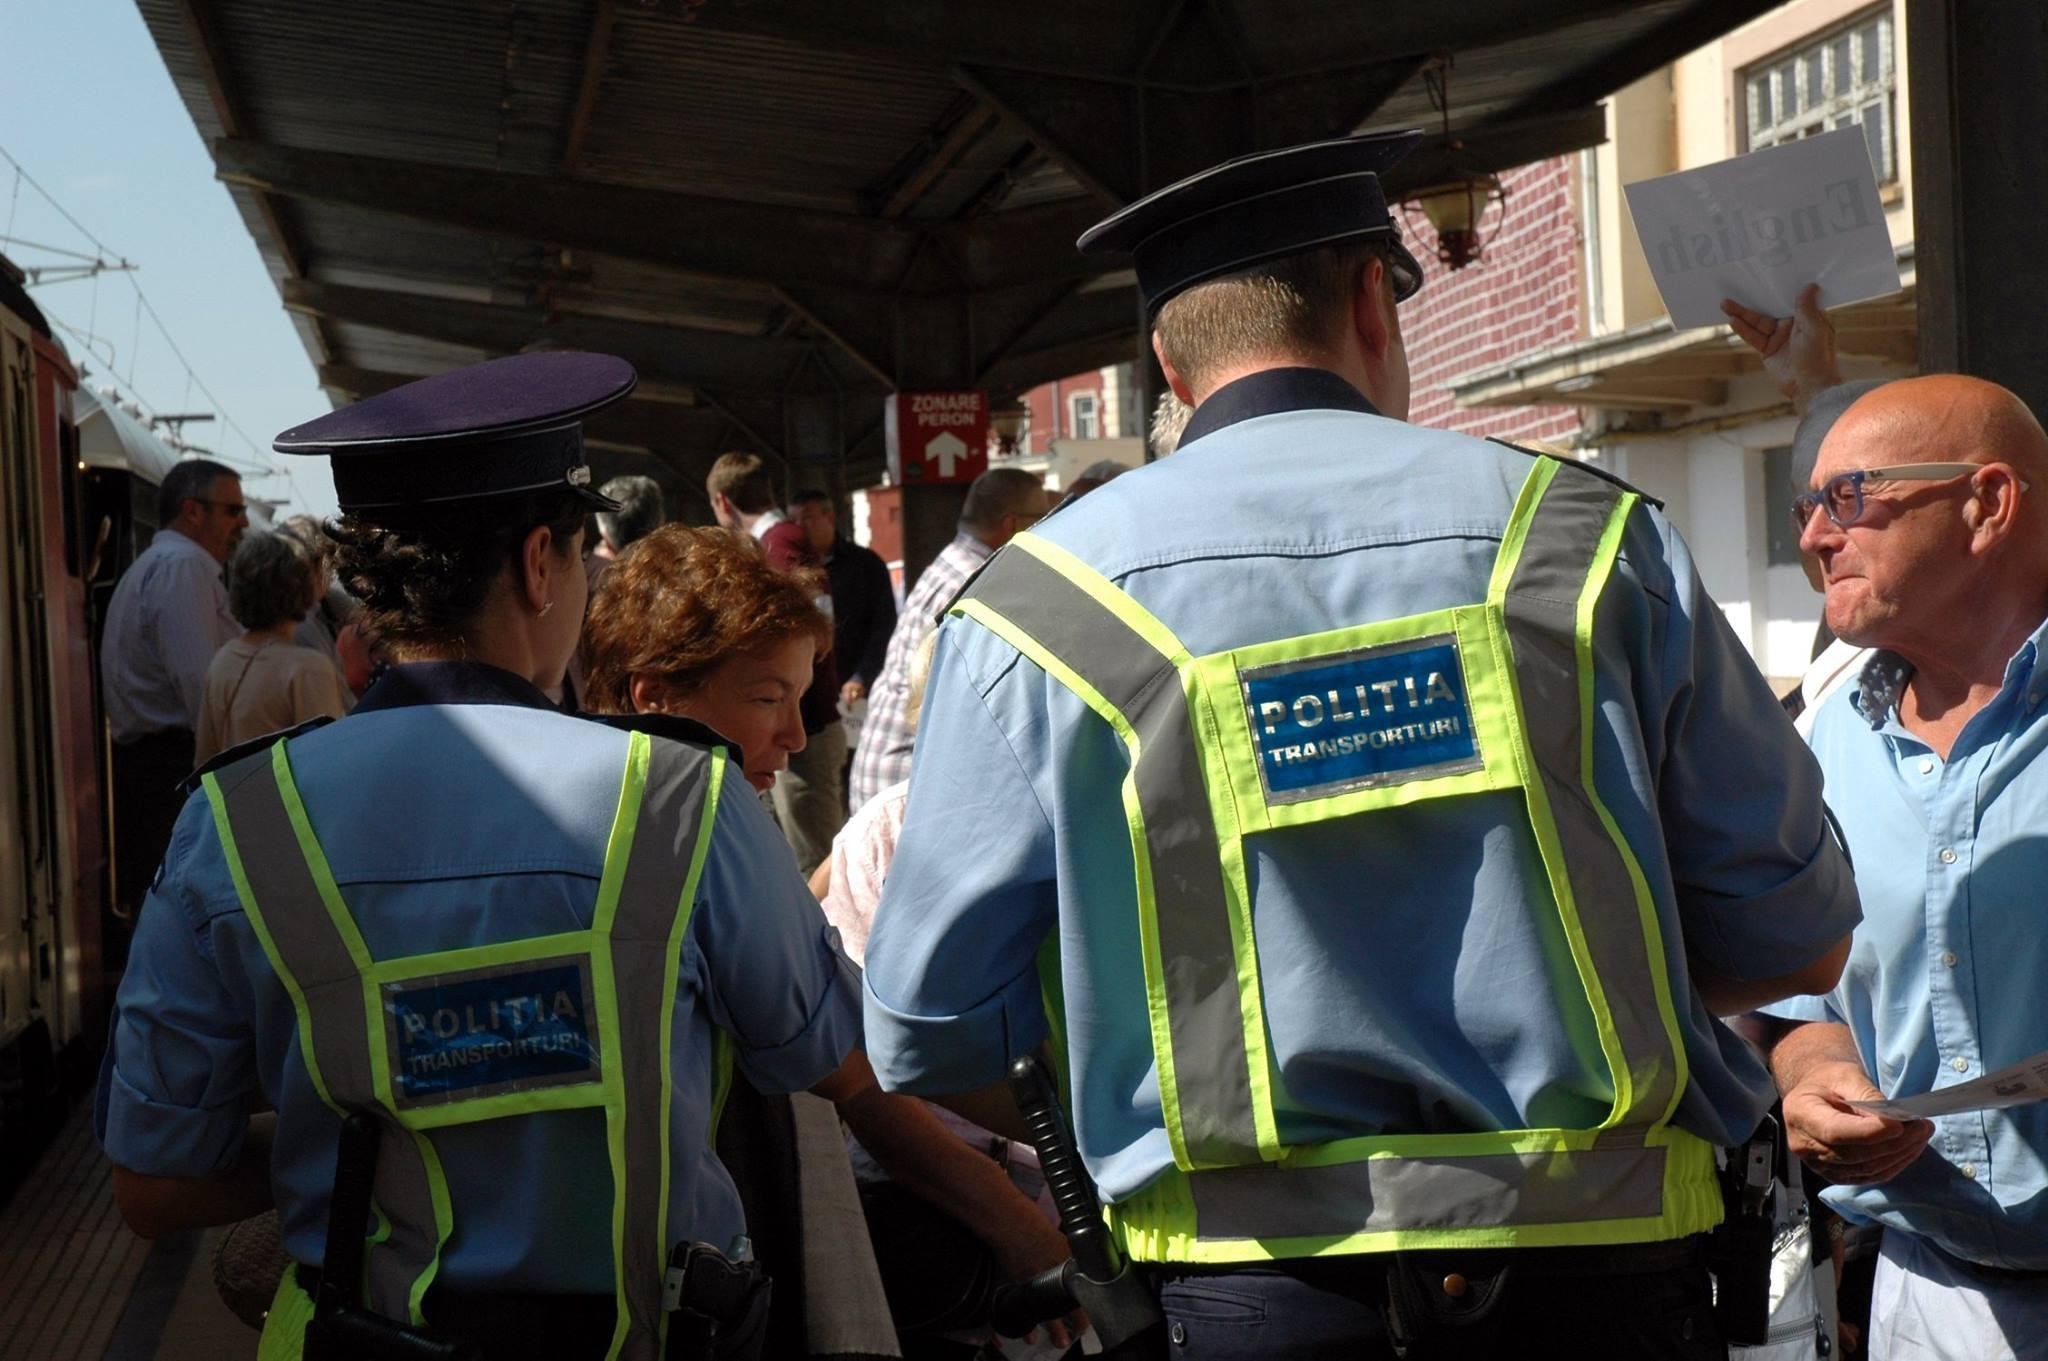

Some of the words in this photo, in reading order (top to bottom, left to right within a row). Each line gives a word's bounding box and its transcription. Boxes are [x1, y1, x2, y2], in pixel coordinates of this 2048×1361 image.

[911, 393, 981, 413] ZONARE
[918, 412, 976, 427] PERON
[1260, 671, 1457, 735] POLITIA
[1268, 715, 1462, 766] TRANSPORTURI
[403, 990, 577, 1044] POLITIA
[407, 1032, 580, 1075] TRANSPORTURI
